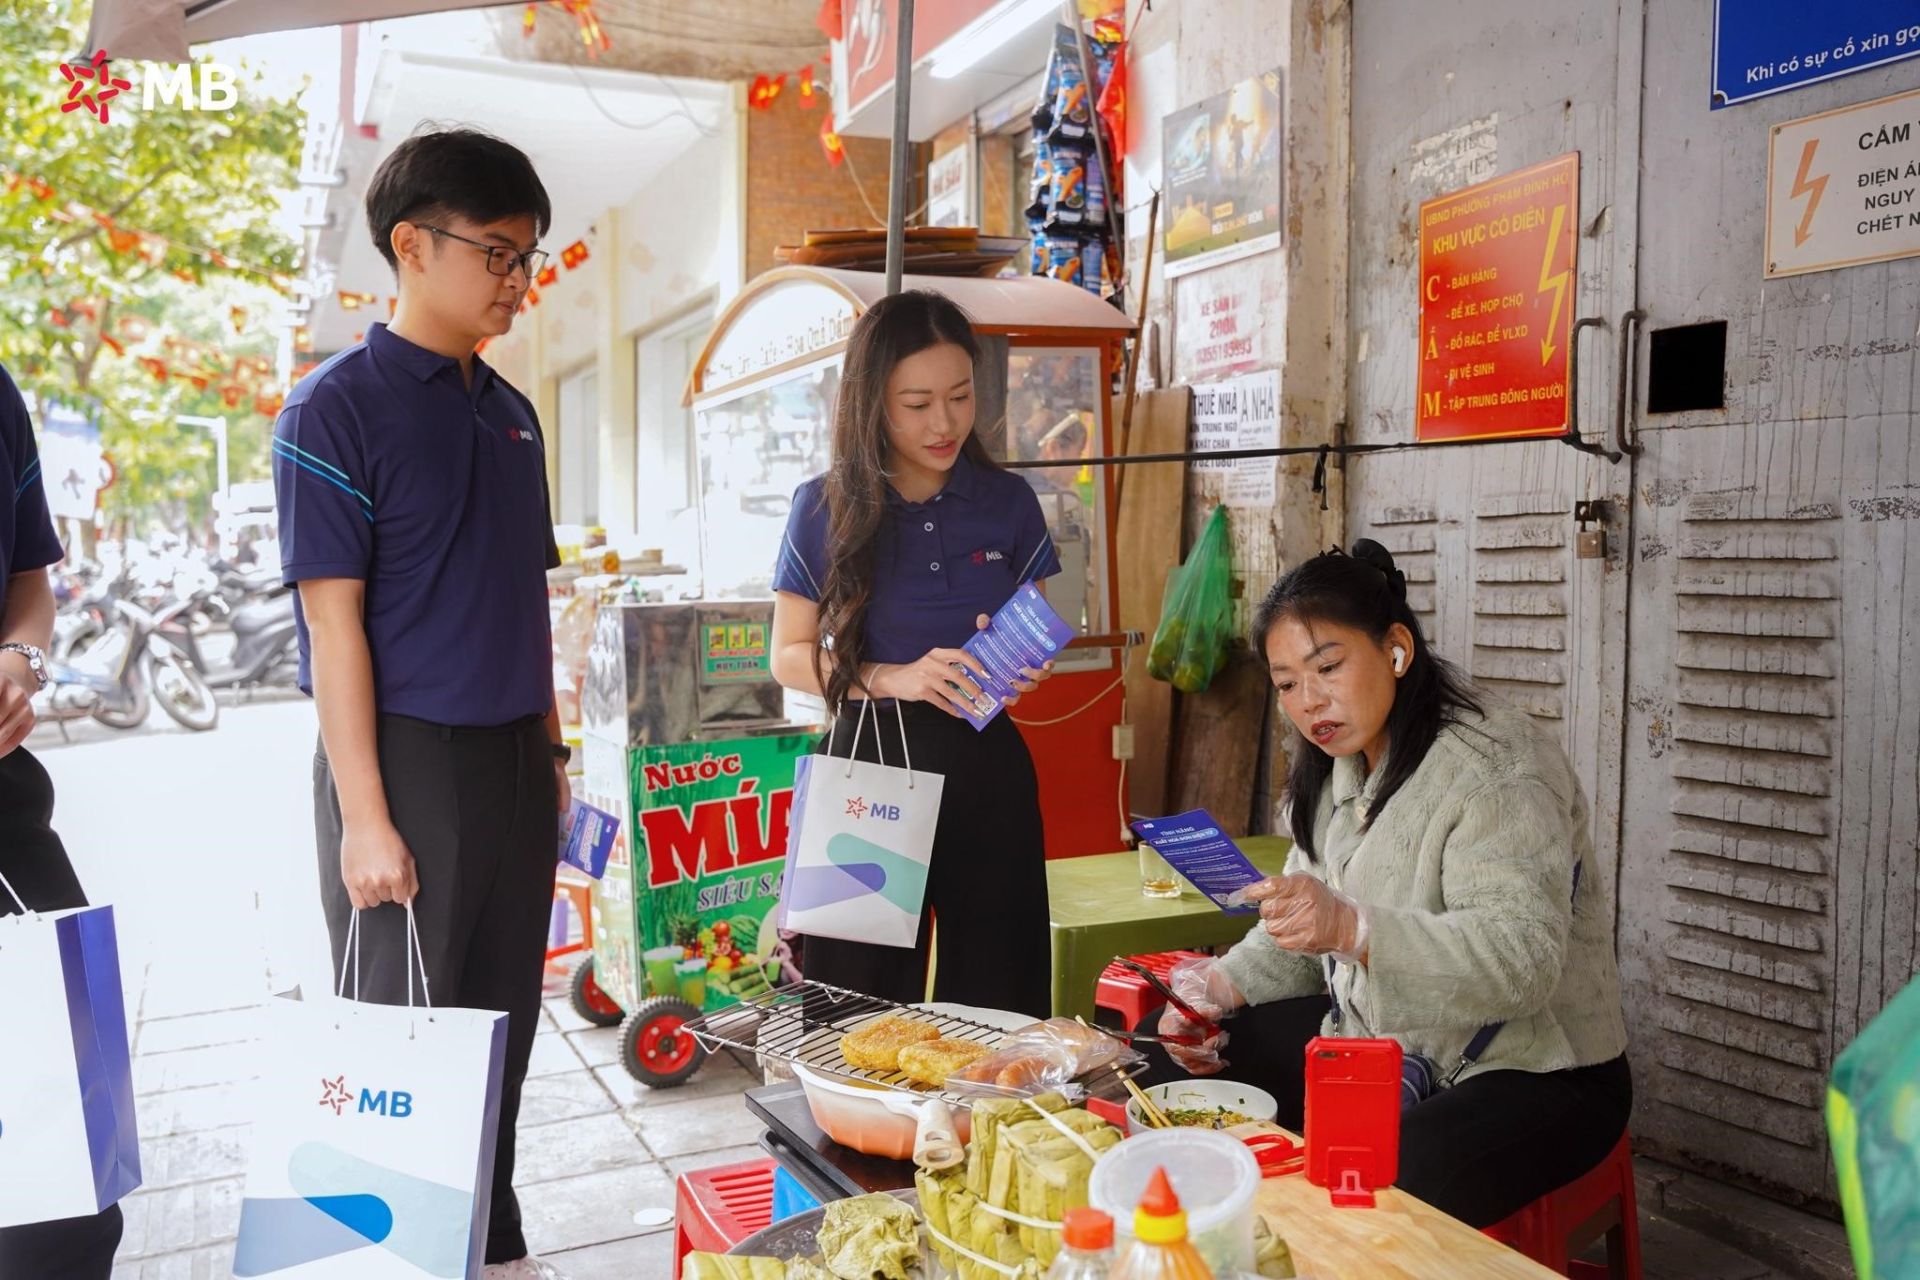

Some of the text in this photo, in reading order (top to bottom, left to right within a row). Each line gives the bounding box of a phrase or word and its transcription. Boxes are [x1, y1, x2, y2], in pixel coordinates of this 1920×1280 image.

[1747, 63, 1774, 83] Khi
[1778, 55, 1799, 75] có
[1804, 50, 1829, 68] sự
[1833, 36, 1855, 59] cố
[1861, 33, 1889, 52] xin
[1858, 123, 1911, 151] CẤM
[1857, 160, 1920, 189] ĐIỆN Á
[1864, 187, 1915, 210] NGUY
[1426, 209, 1451, 226] UBND
[1433, 205, 1546, 255] KHU VỰC CÓ ĐIỆN
[1857, 213, 1903, 235] CHẾT
[1426, 274, 1440, 302] C
[1451, 272, 1470, 290] BÁN
[1471, 266, 1498, 284] HÀNG
[1502, 324, 1528, 340] VLXD
[1460, 362, 1472, 380] VỆ
[1473, 362, 1495, 377] SINH
[1218, 386, 1237, 416] NHÀ
[1423, 390, 1442, 418] M
[1448, 396, 1465, 413] TẬP
[1467, 393, 1498, 408] TRUNG
[1500, 388, 1529, 404] ĐÔNG
[1531, 382, 1564, 401] NGƯỜI
[985, 551, 1003, 561] MB
[643, 752, 742, 793] Nước
[870, 802, 900, 821] MB
[697, 876, 754, 912] SIÊU
[358, 1088, 413, 1118] MB
